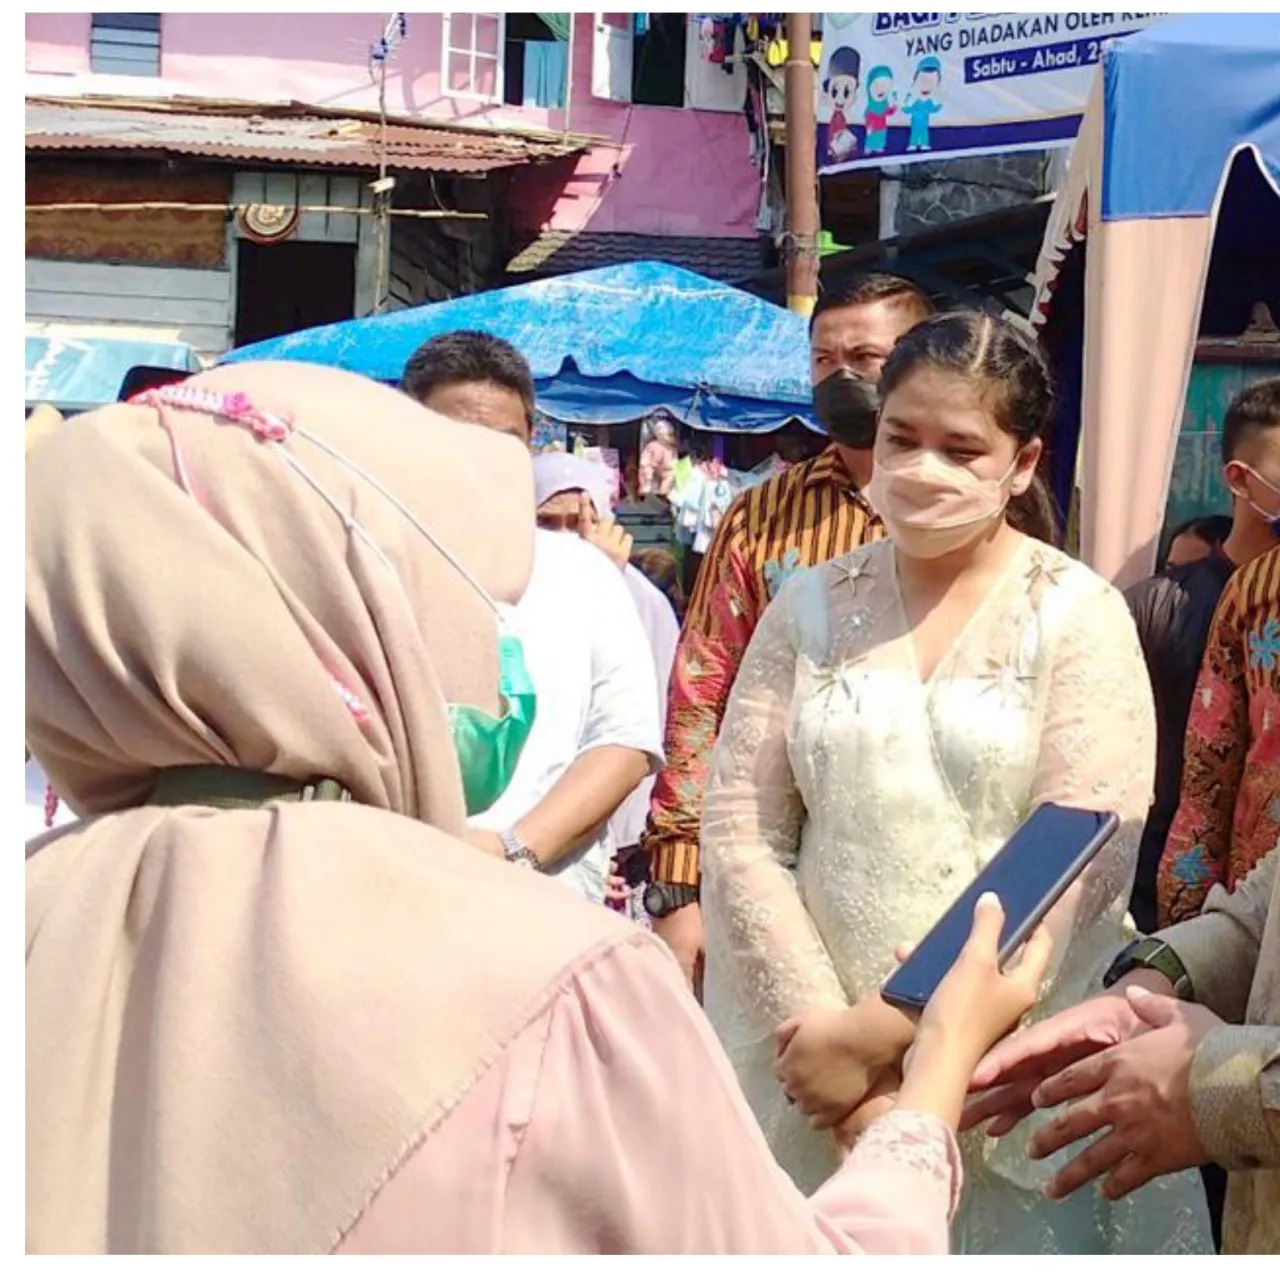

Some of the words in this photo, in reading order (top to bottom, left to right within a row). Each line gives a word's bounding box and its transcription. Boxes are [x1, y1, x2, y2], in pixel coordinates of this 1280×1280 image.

[905, 33, 953, 57] YANG
[959, 14, 1059, 48] DIADAKAN
[1065, 12, 1114, 31] OLEH
[972, 56, 1016, 78] Sabtu
[1032, 45, 1082, 70] Ahad,
